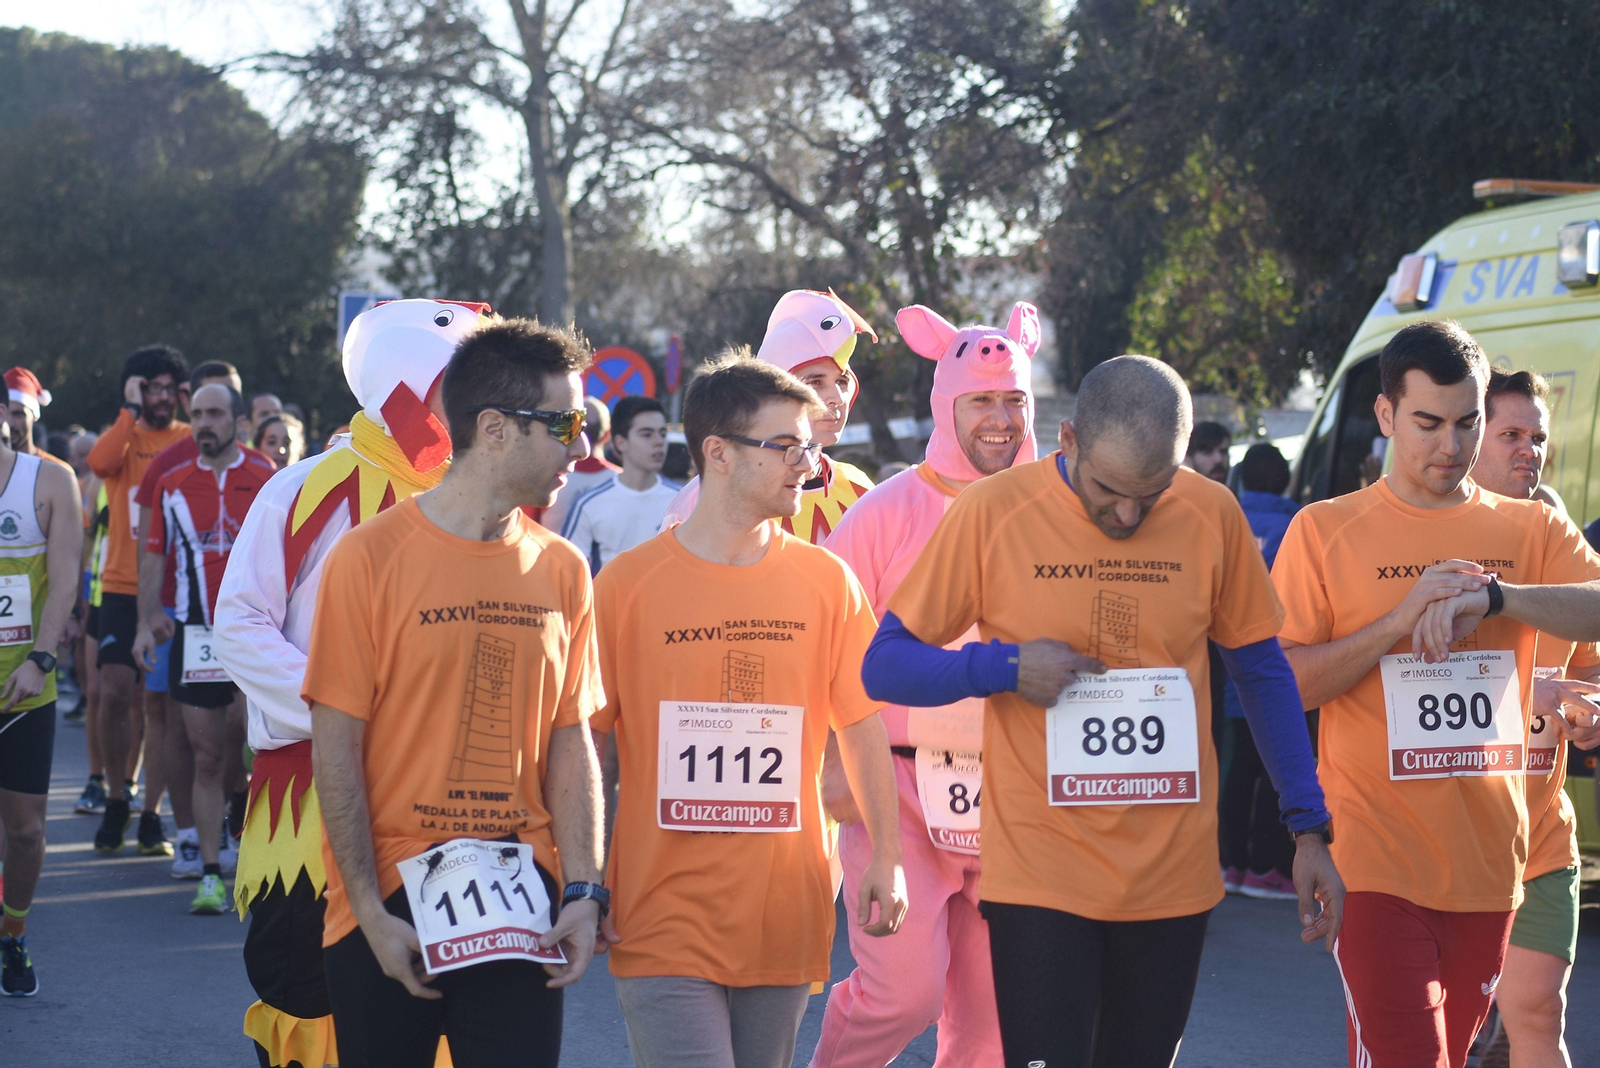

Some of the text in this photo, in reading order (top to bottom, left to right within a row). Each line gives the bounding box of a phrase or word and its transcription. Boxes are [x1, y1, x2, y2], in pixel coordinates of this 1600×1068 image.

[1463, 255, 1540, 304] SVA
[1034, 564, 1093, 579] XXXVI
[1098, 559, 1183, 572] SAN SILVESTRE
[1377, 565, 1430, 580] XXXV
[1098, 573, 1169, 583] CORDOBESA
[0, 595, 13, 618] 2
[477, 600, 500, 611] SAN
[419, 606, 476, 626] XXXVI
[477, 614, 544, 628] CORDOBESA
[725, 619, 806, 630] SAN SILVESTRE
[664, 627, 722, 645] XXXVI
[726, 631, 793, 642] CORDOBESA
[200, 645, 218, 662] 3
[1467, 654, 1501, 662] Cordobesa
[1412, 669, 1453, 679] IMDECO
[1079, 689, 1124, 700] IMDECO
[677, 705, 704, 713] XXXVI
[720, 706, 749, 714] Silvestre
[751, 707, 788, 715] Cordobesa
[1418, 692, 1493, 731] 890
[691, 719, 733, 729] IMDECO
[1082, 715, 1165, 756] 889
[679, 745, 783, 784] 1112
[1402, 749, 1499, 770] Cruzcampo
[1505, 750, 1514, 766] SIN
[1062, 776, 1187, 798] Cruzcampo SIN
[413, 803, 471, 818] MEDALLA
[472, 810, 486, 818] DE
[670, 801, 788, 825] Cruzcampo SIN
[421, 819, 436, 829] LA
[440, 822, 449, 832] J.
[453, 822, 469, 832] DE
[939, 827, 981, 848] Cruzc
[435, 853, 478, 875] IMDECO
[435, 879, 536, 927] 1111
[437, 931, 540, 961] Cruzcampo
